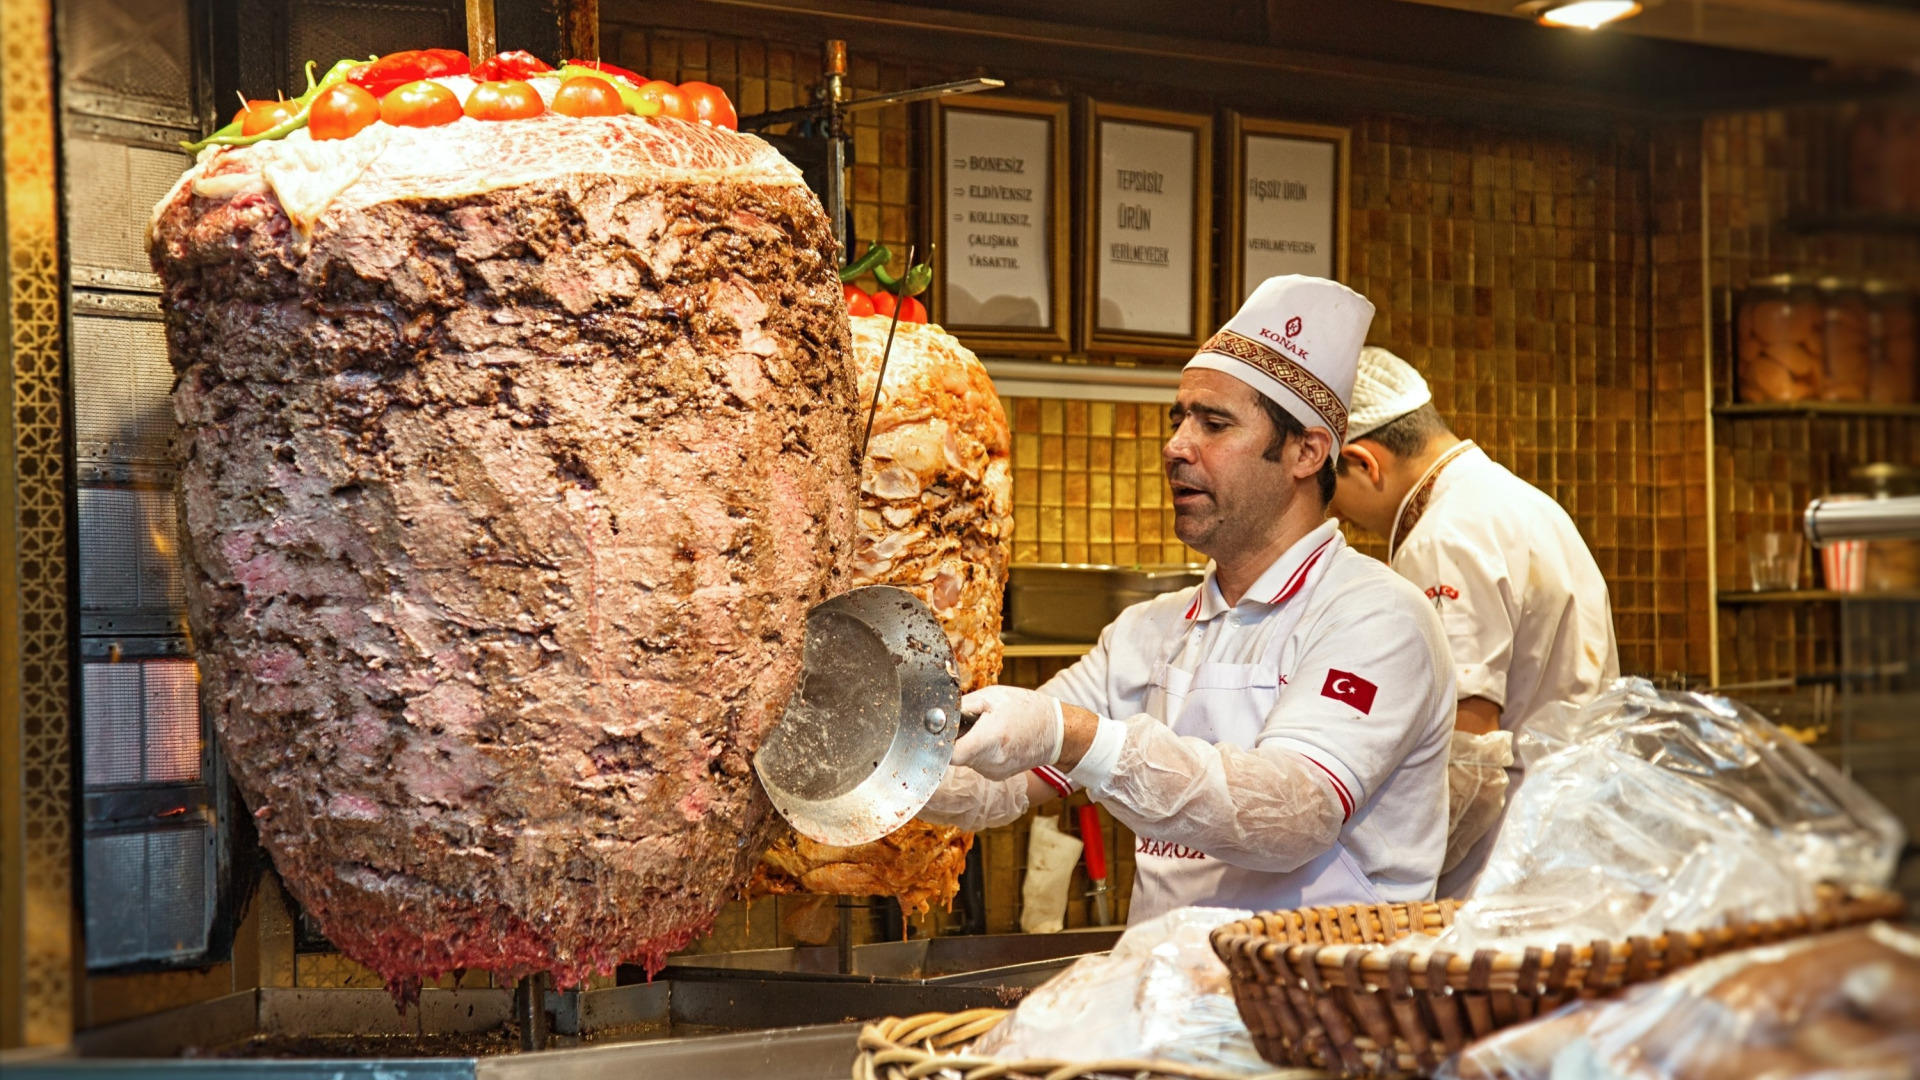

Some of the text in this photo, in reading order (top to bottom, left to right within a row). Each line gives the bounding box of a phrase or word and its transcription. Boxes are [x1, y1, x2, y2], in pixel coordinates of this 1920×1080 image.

[1116, 169, 1164, 194] TEPSİSİZ
[1117, 202, 1151, 231] ÜRÜN
[967, 233, 1020, 250] ÇALIŞMAK
[1259, 327, 1309, 360] KONAK
